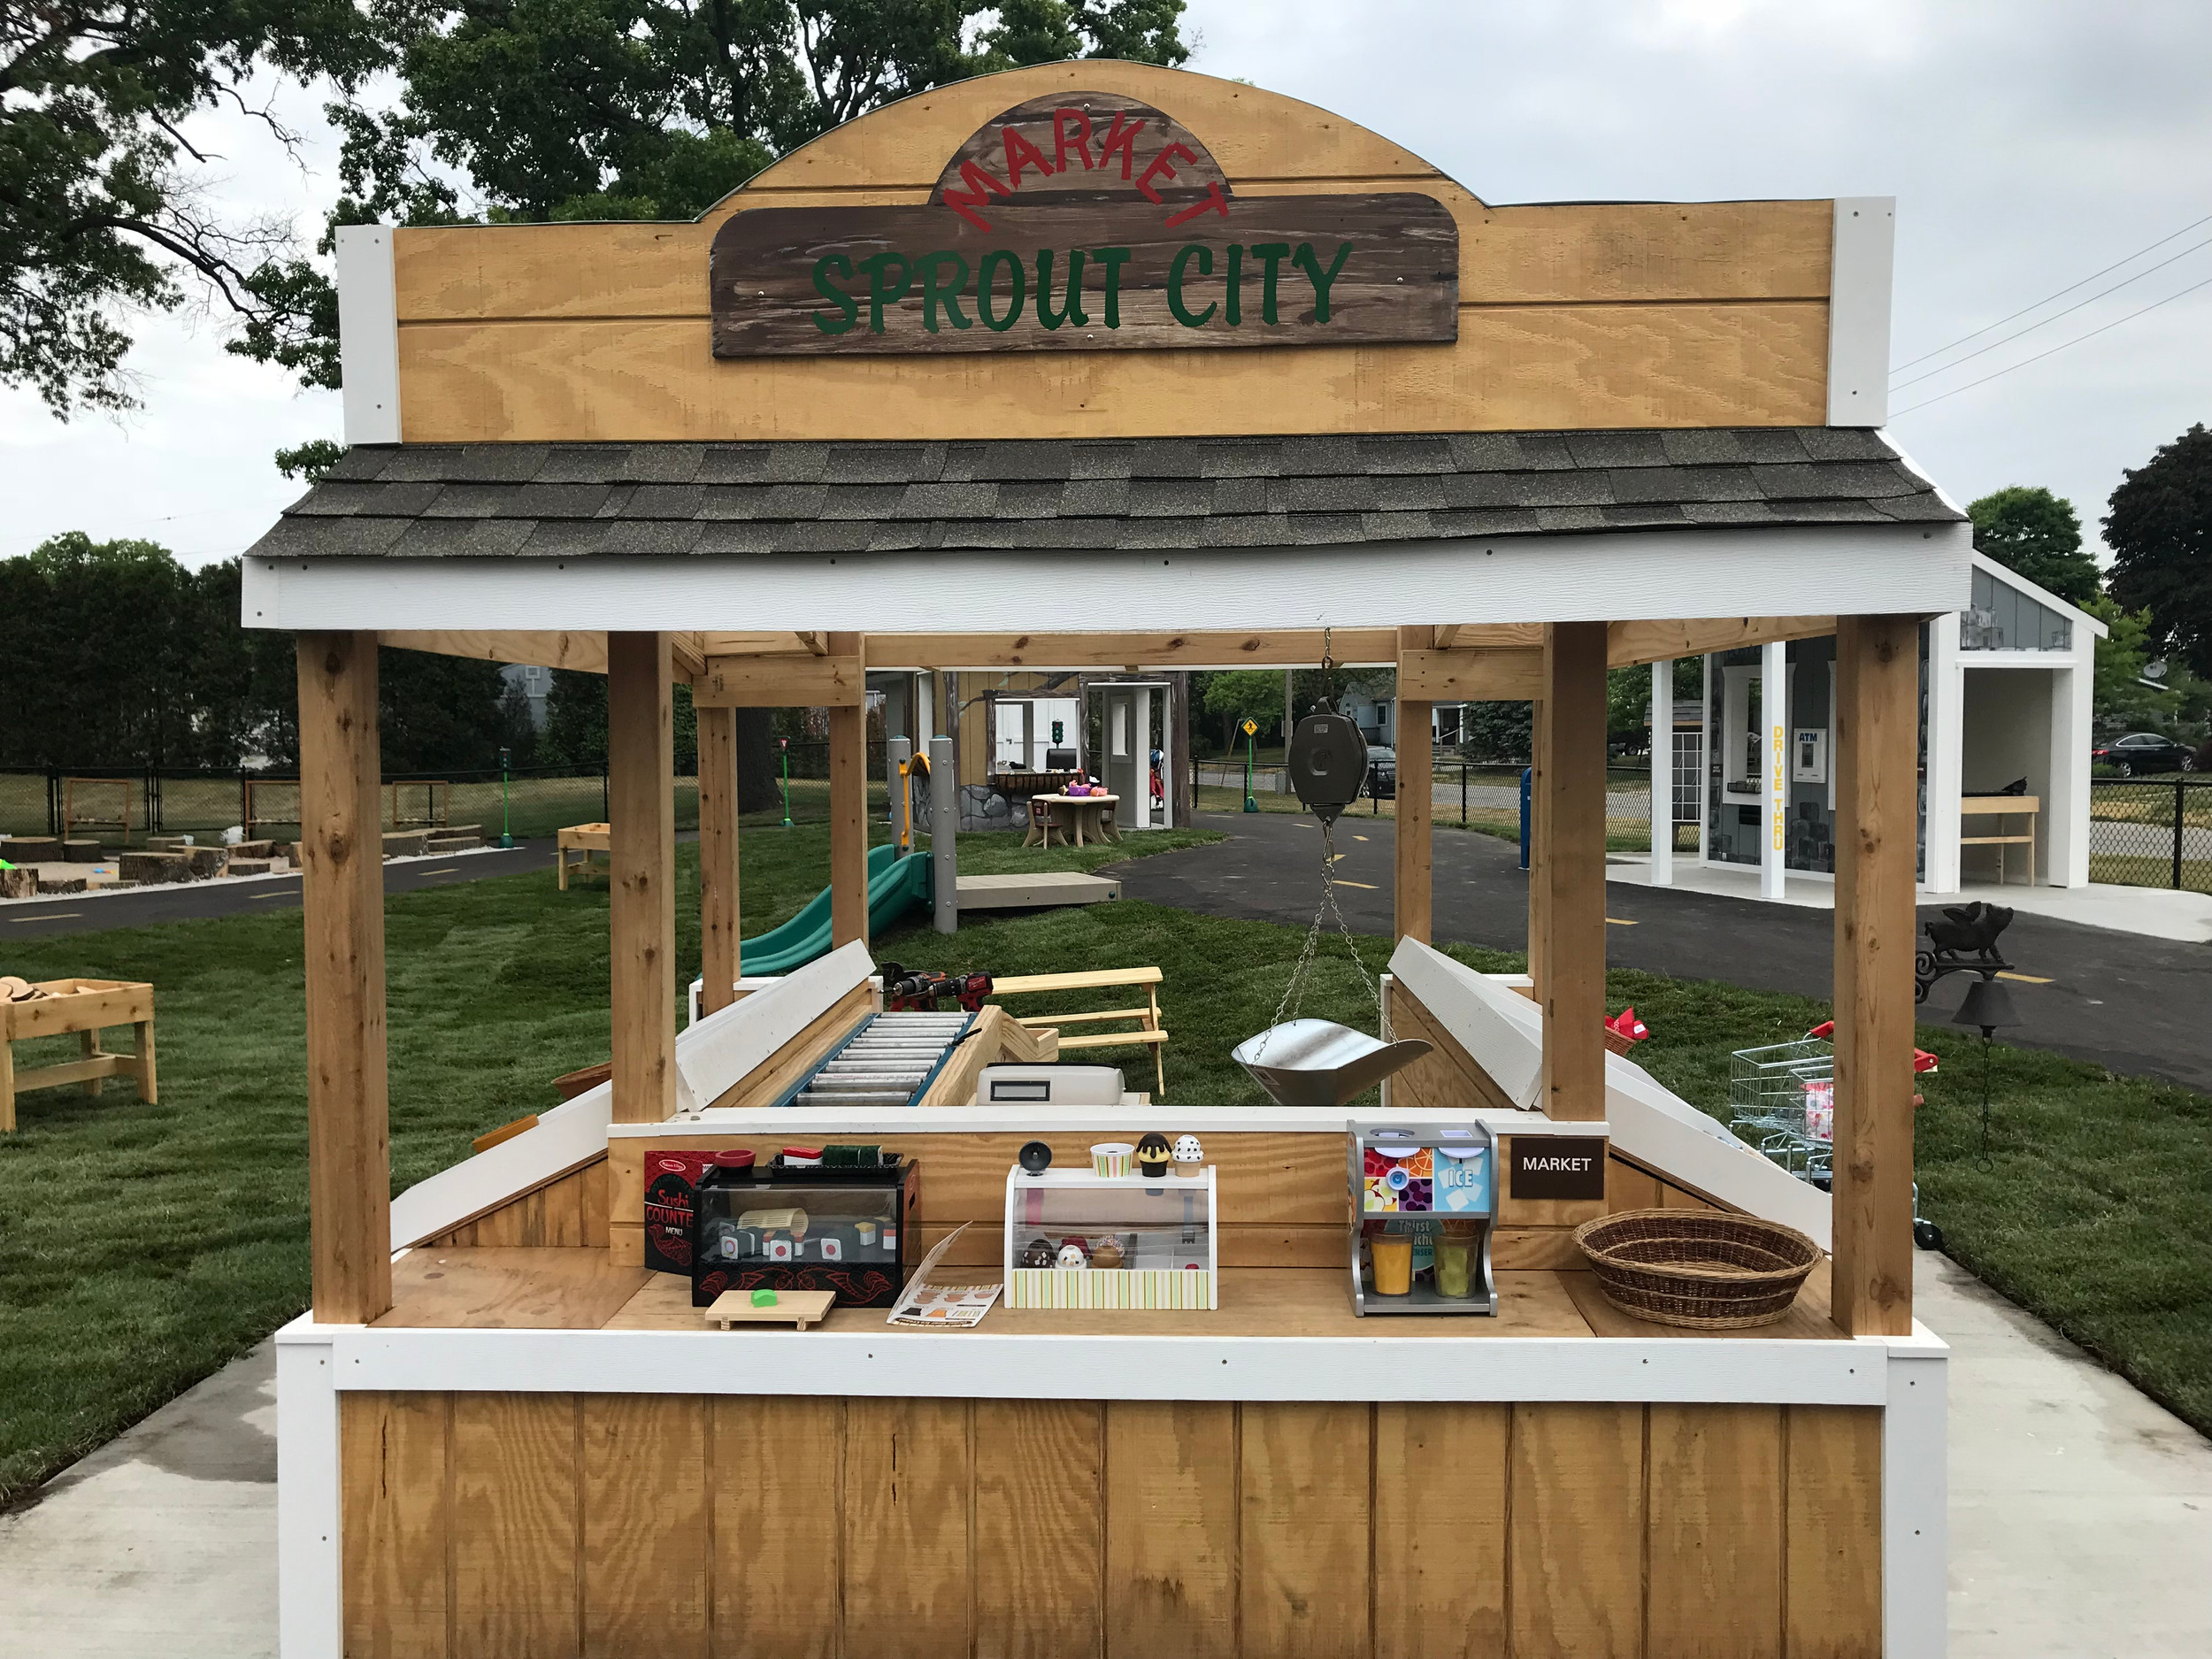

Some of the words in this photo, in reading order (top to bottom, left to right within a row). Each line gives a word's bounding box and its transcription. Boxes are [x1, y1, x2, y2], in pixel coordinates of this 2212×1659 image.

[942, 108, 1229, 233] MARKET
[811, 247, 1131, 337] SPROUT
[1166, 242, 1353, 328] CITY
[1799, 733, 1817, 742] ATM
[1773, 726, 1784, 791] DRIVE
[1773, 798, 1784, 850] THRU
[1523, 1157, 1592, 1171] MARKET
[1448, 1170, 1473, 1187] ICE
[657, 1188, 690, 1209] Sushi
[646, 1205, 694, 1228] COUNTE
[665, 1226, 683, 1236] MENU
